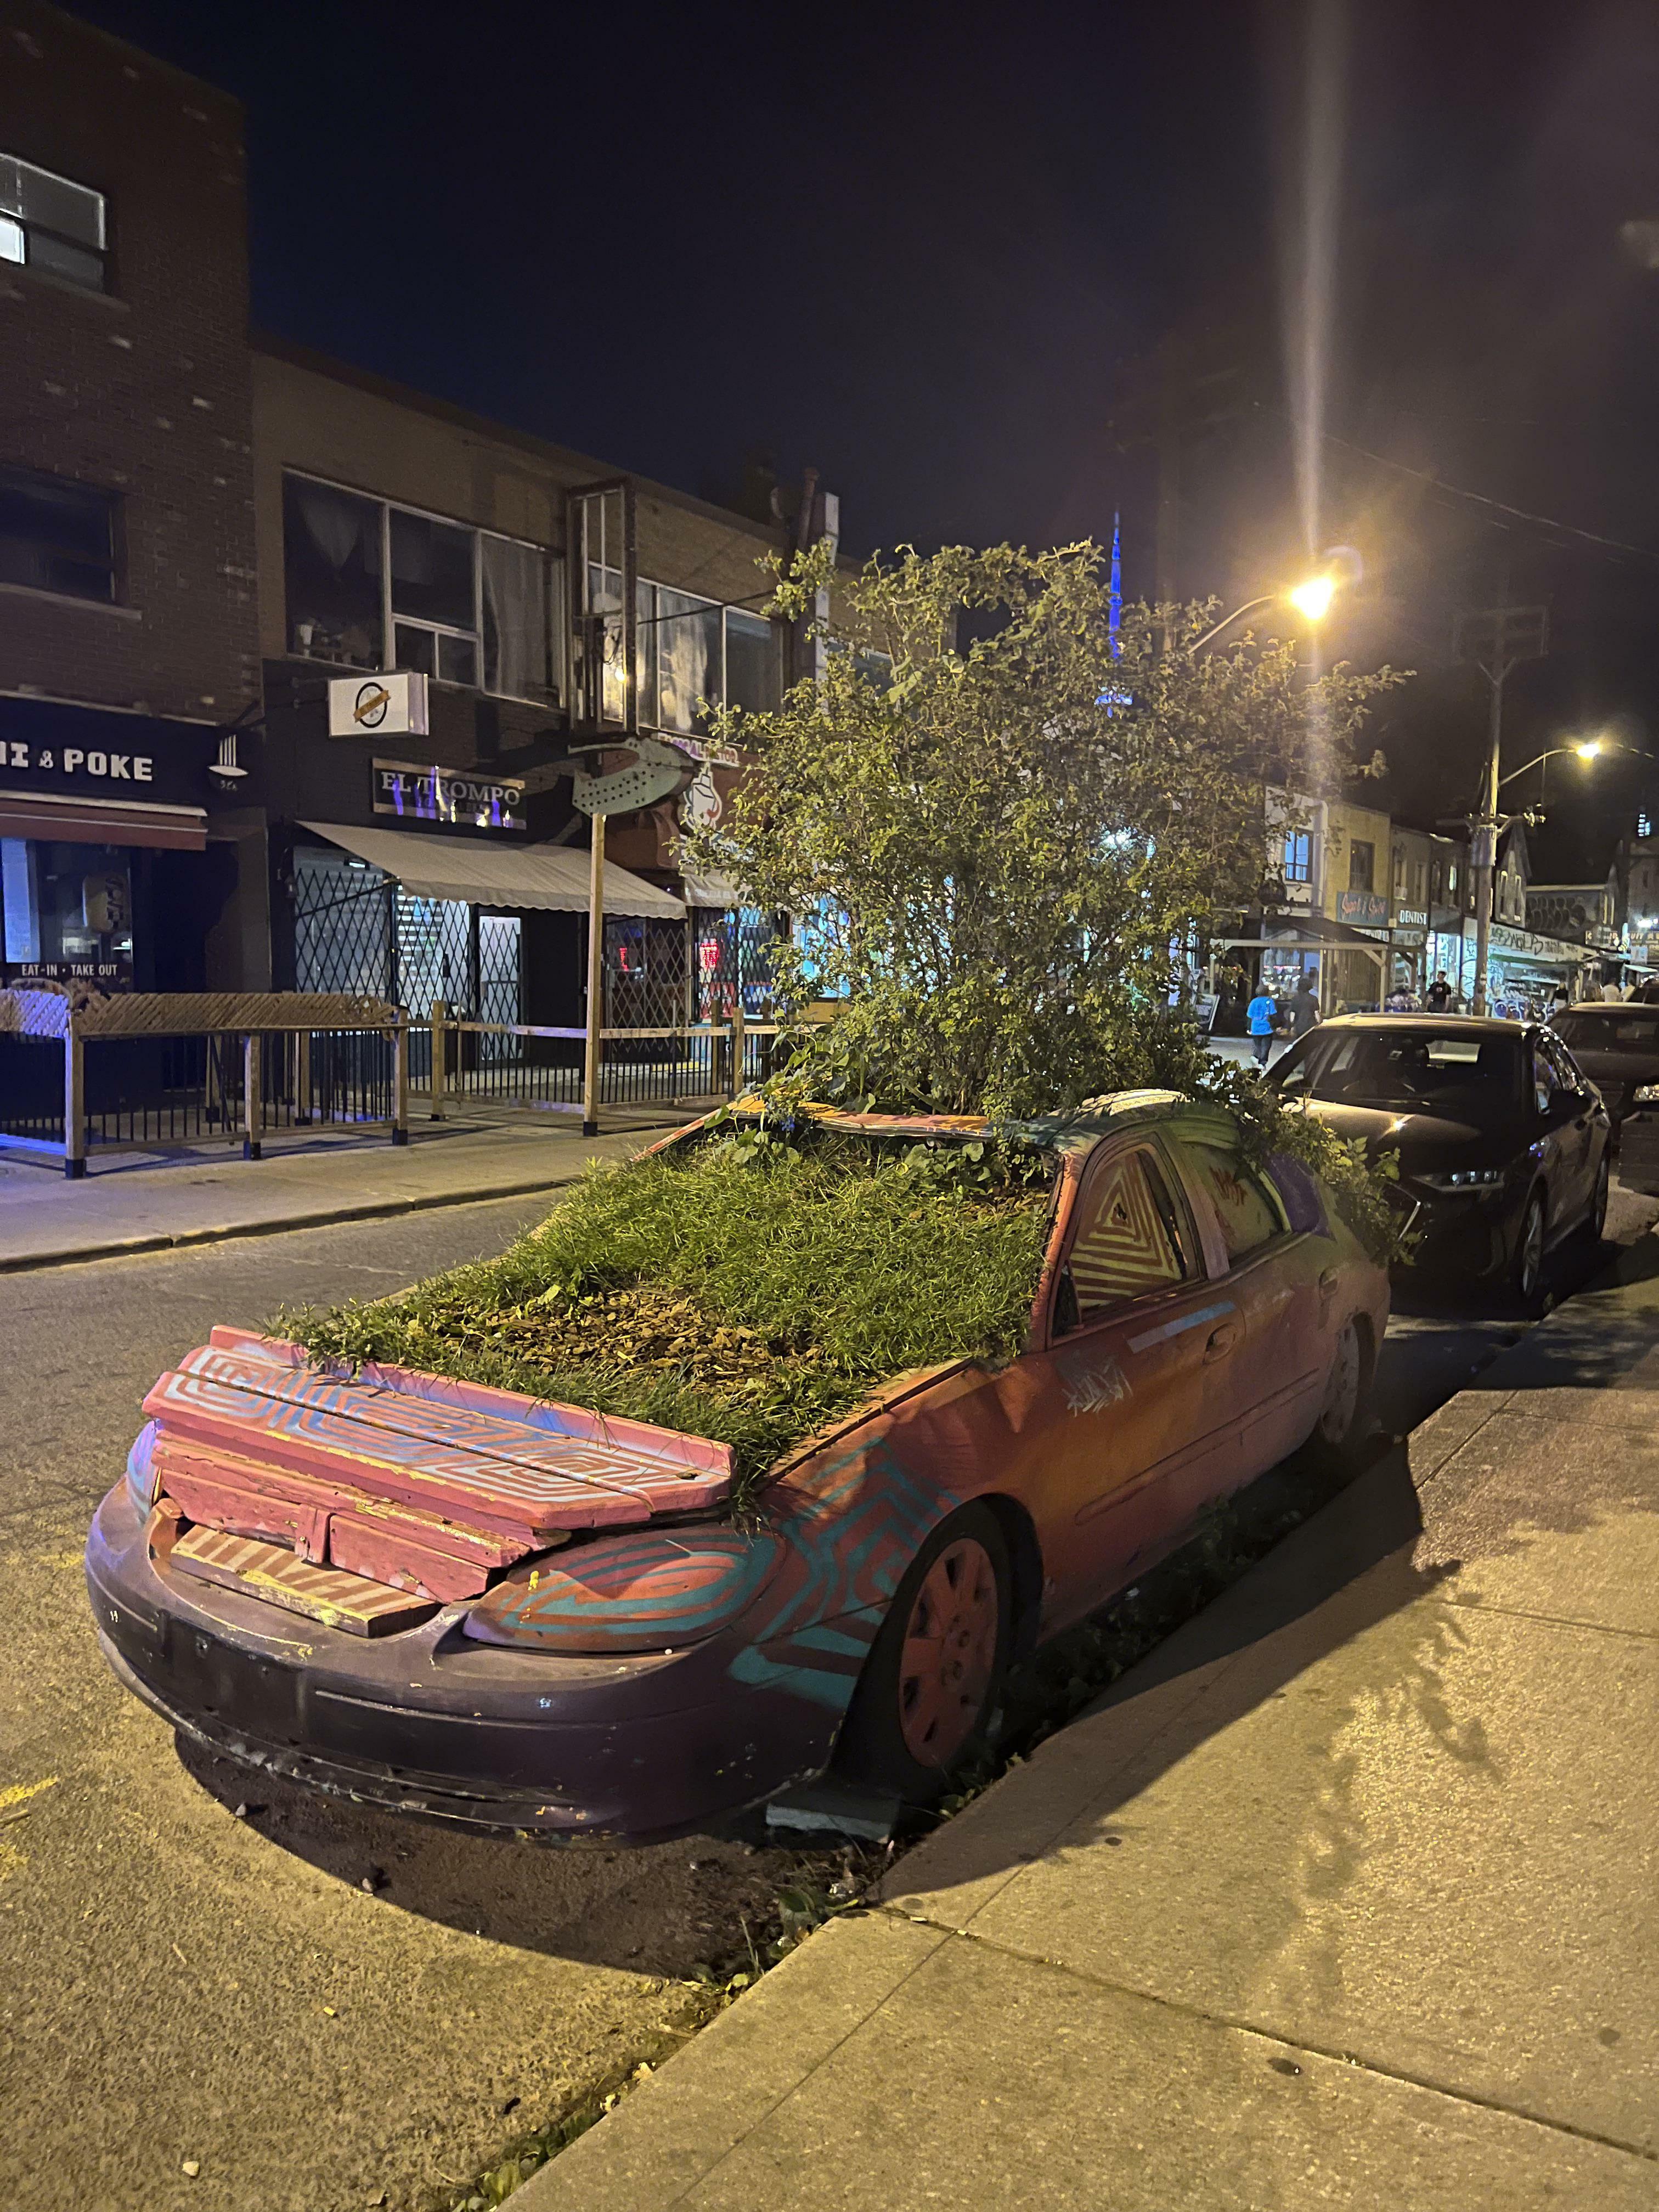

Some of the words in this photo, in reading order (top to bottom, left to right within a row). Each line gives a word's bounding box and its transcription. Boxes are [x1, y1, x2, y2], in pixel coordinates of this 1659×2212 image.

[38, 750, 54, 769] &
[64, 748, 153, 781] POKE
[381, 771, 411, 792] EL
[417, 776, 520, 805] TROMPO
[1400, 910, 1427, 925] DENTIST
[21, 964, 58, 976] EAT-IN
[71, 964, 94, 976] TAKE
[98, 964, 117, 976] OUT
